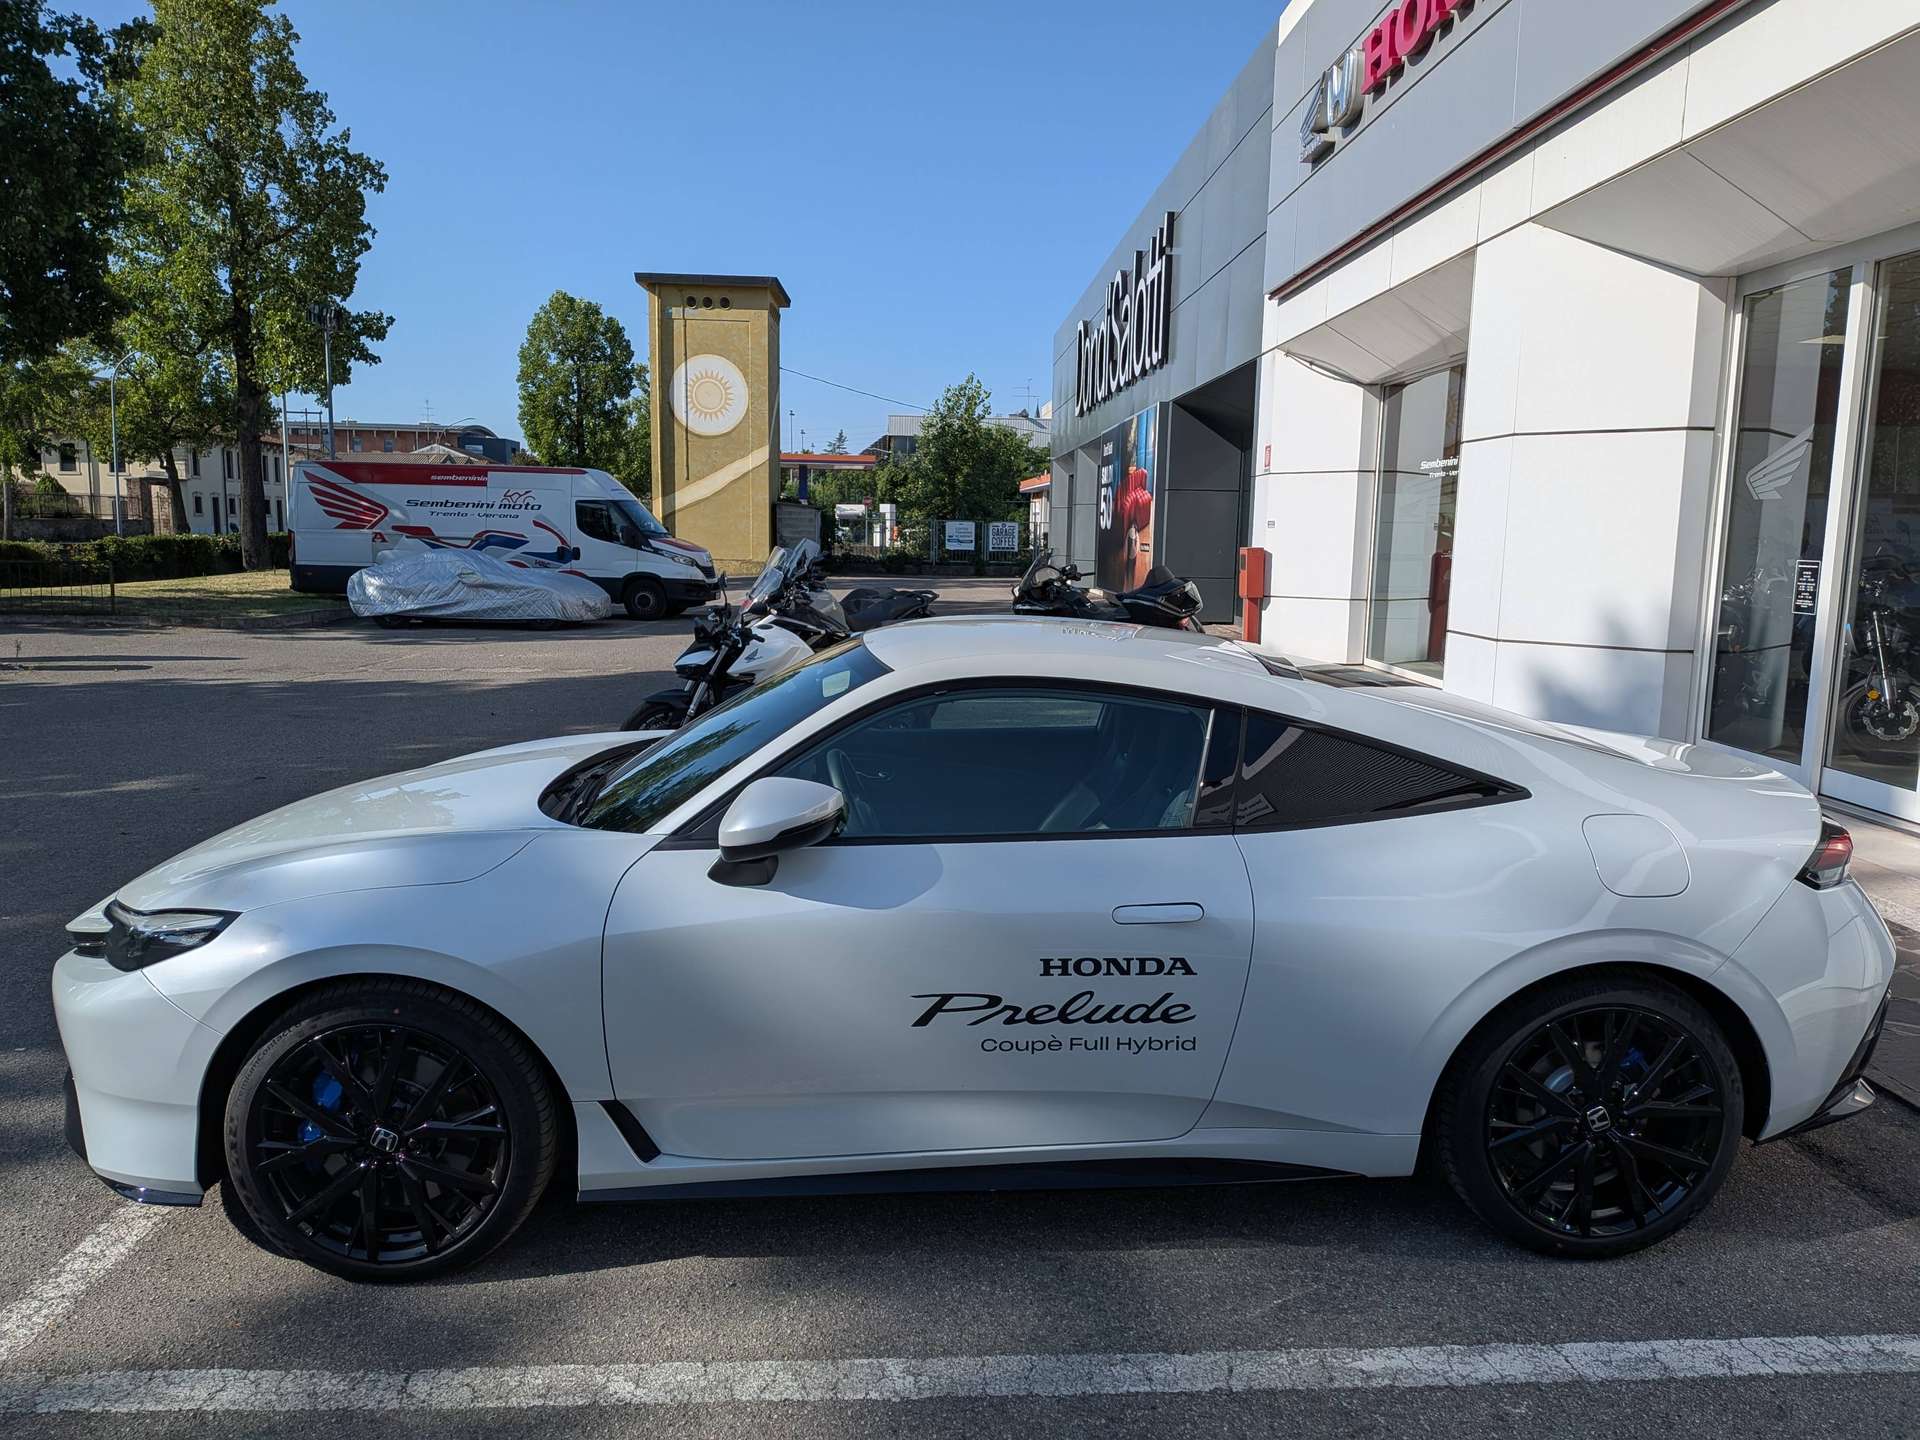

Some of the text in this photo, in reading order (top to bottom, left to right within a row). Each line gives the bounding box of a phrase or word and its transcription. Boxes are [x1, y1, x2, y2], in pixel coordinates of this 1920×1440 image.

[1420, 456, 1459, 469] Sembenini
[405, 499, 542, 511] Sembenini moto
[1100, 486, 1113, 530] 50
[477, 511, 520, 519] Verona
[992, 527, 1017, 537] GARAGE
[992, 536, 1017, 546] COFFEE
[1039, 957, 1198, 976] HONDA
[910, 990, 1198, 1027] Prelude
[980, 1034, 1197, 1055] Coupè Full Hybrid
